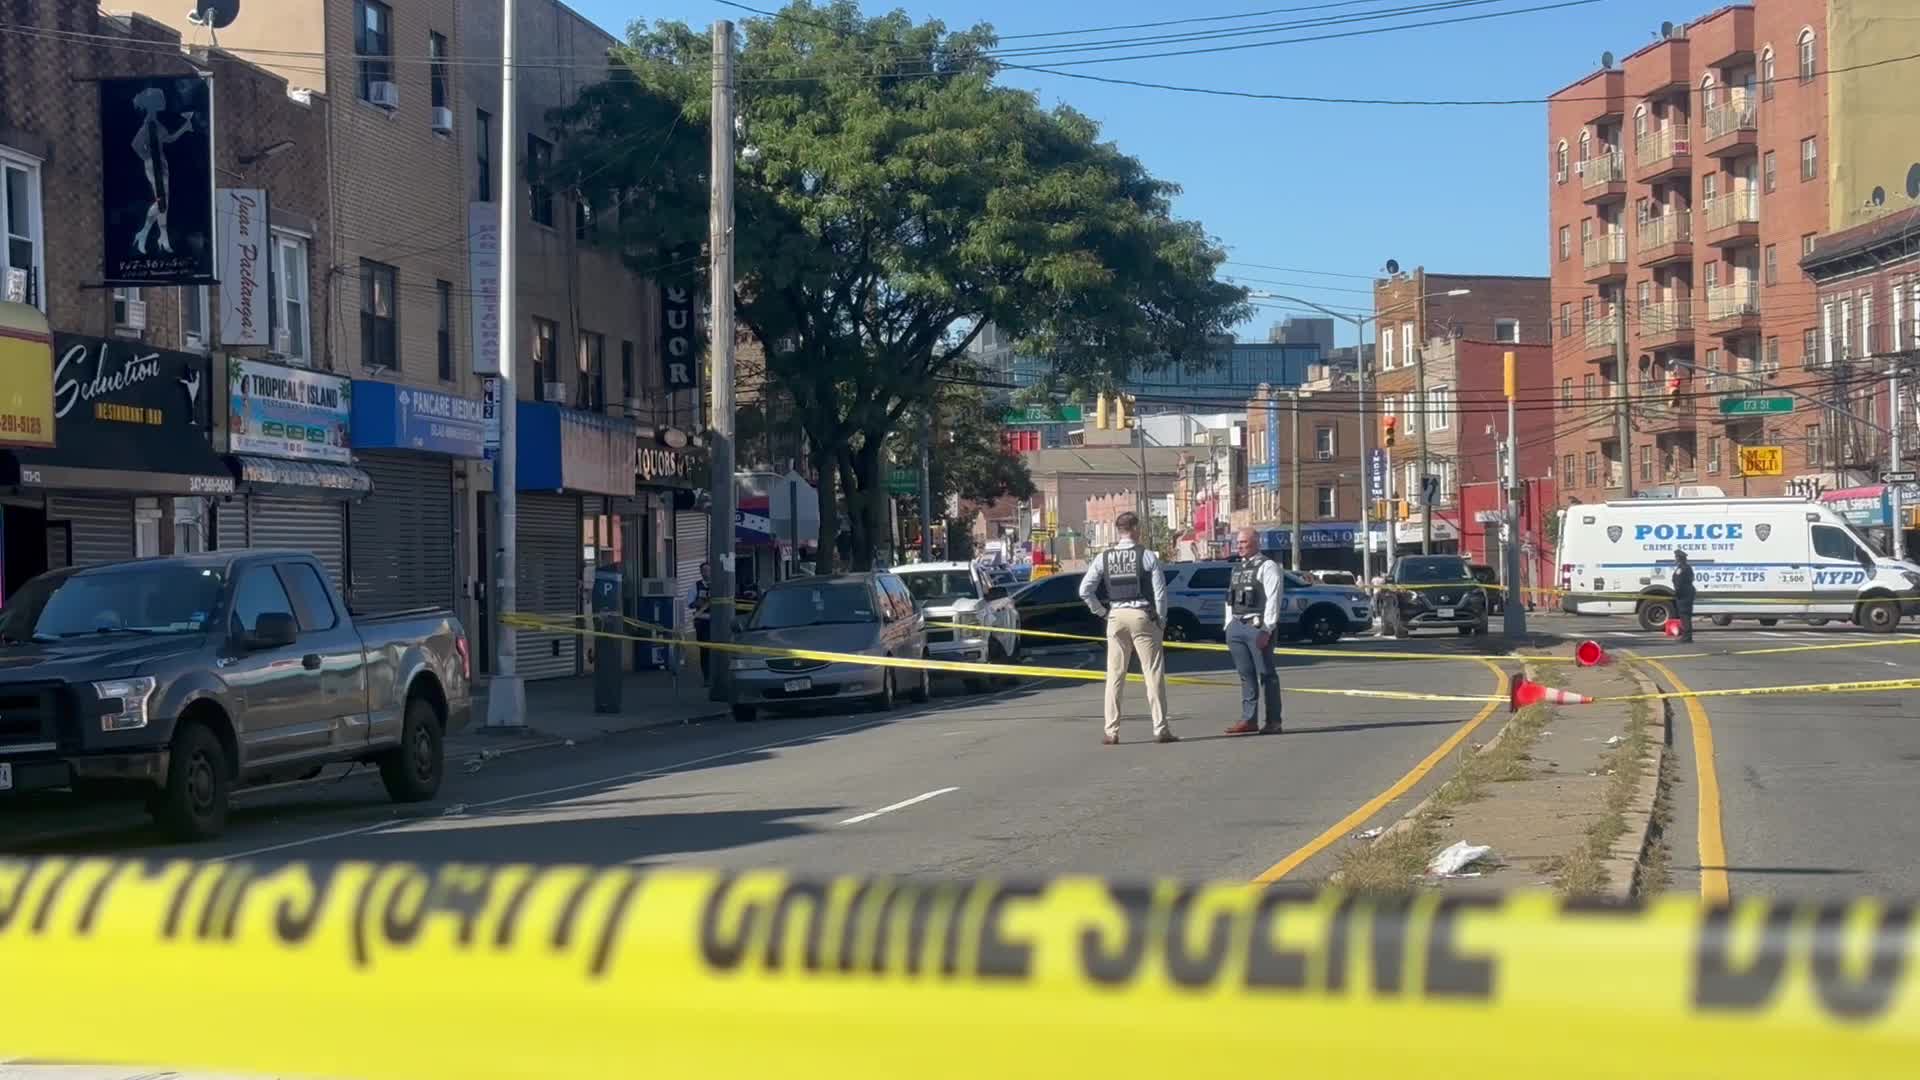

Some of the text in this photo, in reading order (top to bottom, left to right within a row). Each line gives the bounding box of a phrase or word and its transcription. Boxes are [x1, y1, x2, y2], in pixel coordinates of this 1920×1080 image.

[54, 342, 160, 418] Seduction
[251, 374, 338, 409] TROPICAL ISLAND
[413, 391, 450, 417] PANCARE
[1743, 400, 1770, 410] 173 St
[1290, 531, 1337, 543] edical
[1635, 524, 1743, 540] POLICE
[1642, 543, 1735, 551] CRIME SCENE UNIT
[1107, 550, 1137, 563] NYPD
[1107, 562, 1137, 574] POLICE
[1695, 571, 1766, 583] 00-577-TIPS
[1812, 571, 1866, 585] NYPD
[603, 583, 613, 595] P
